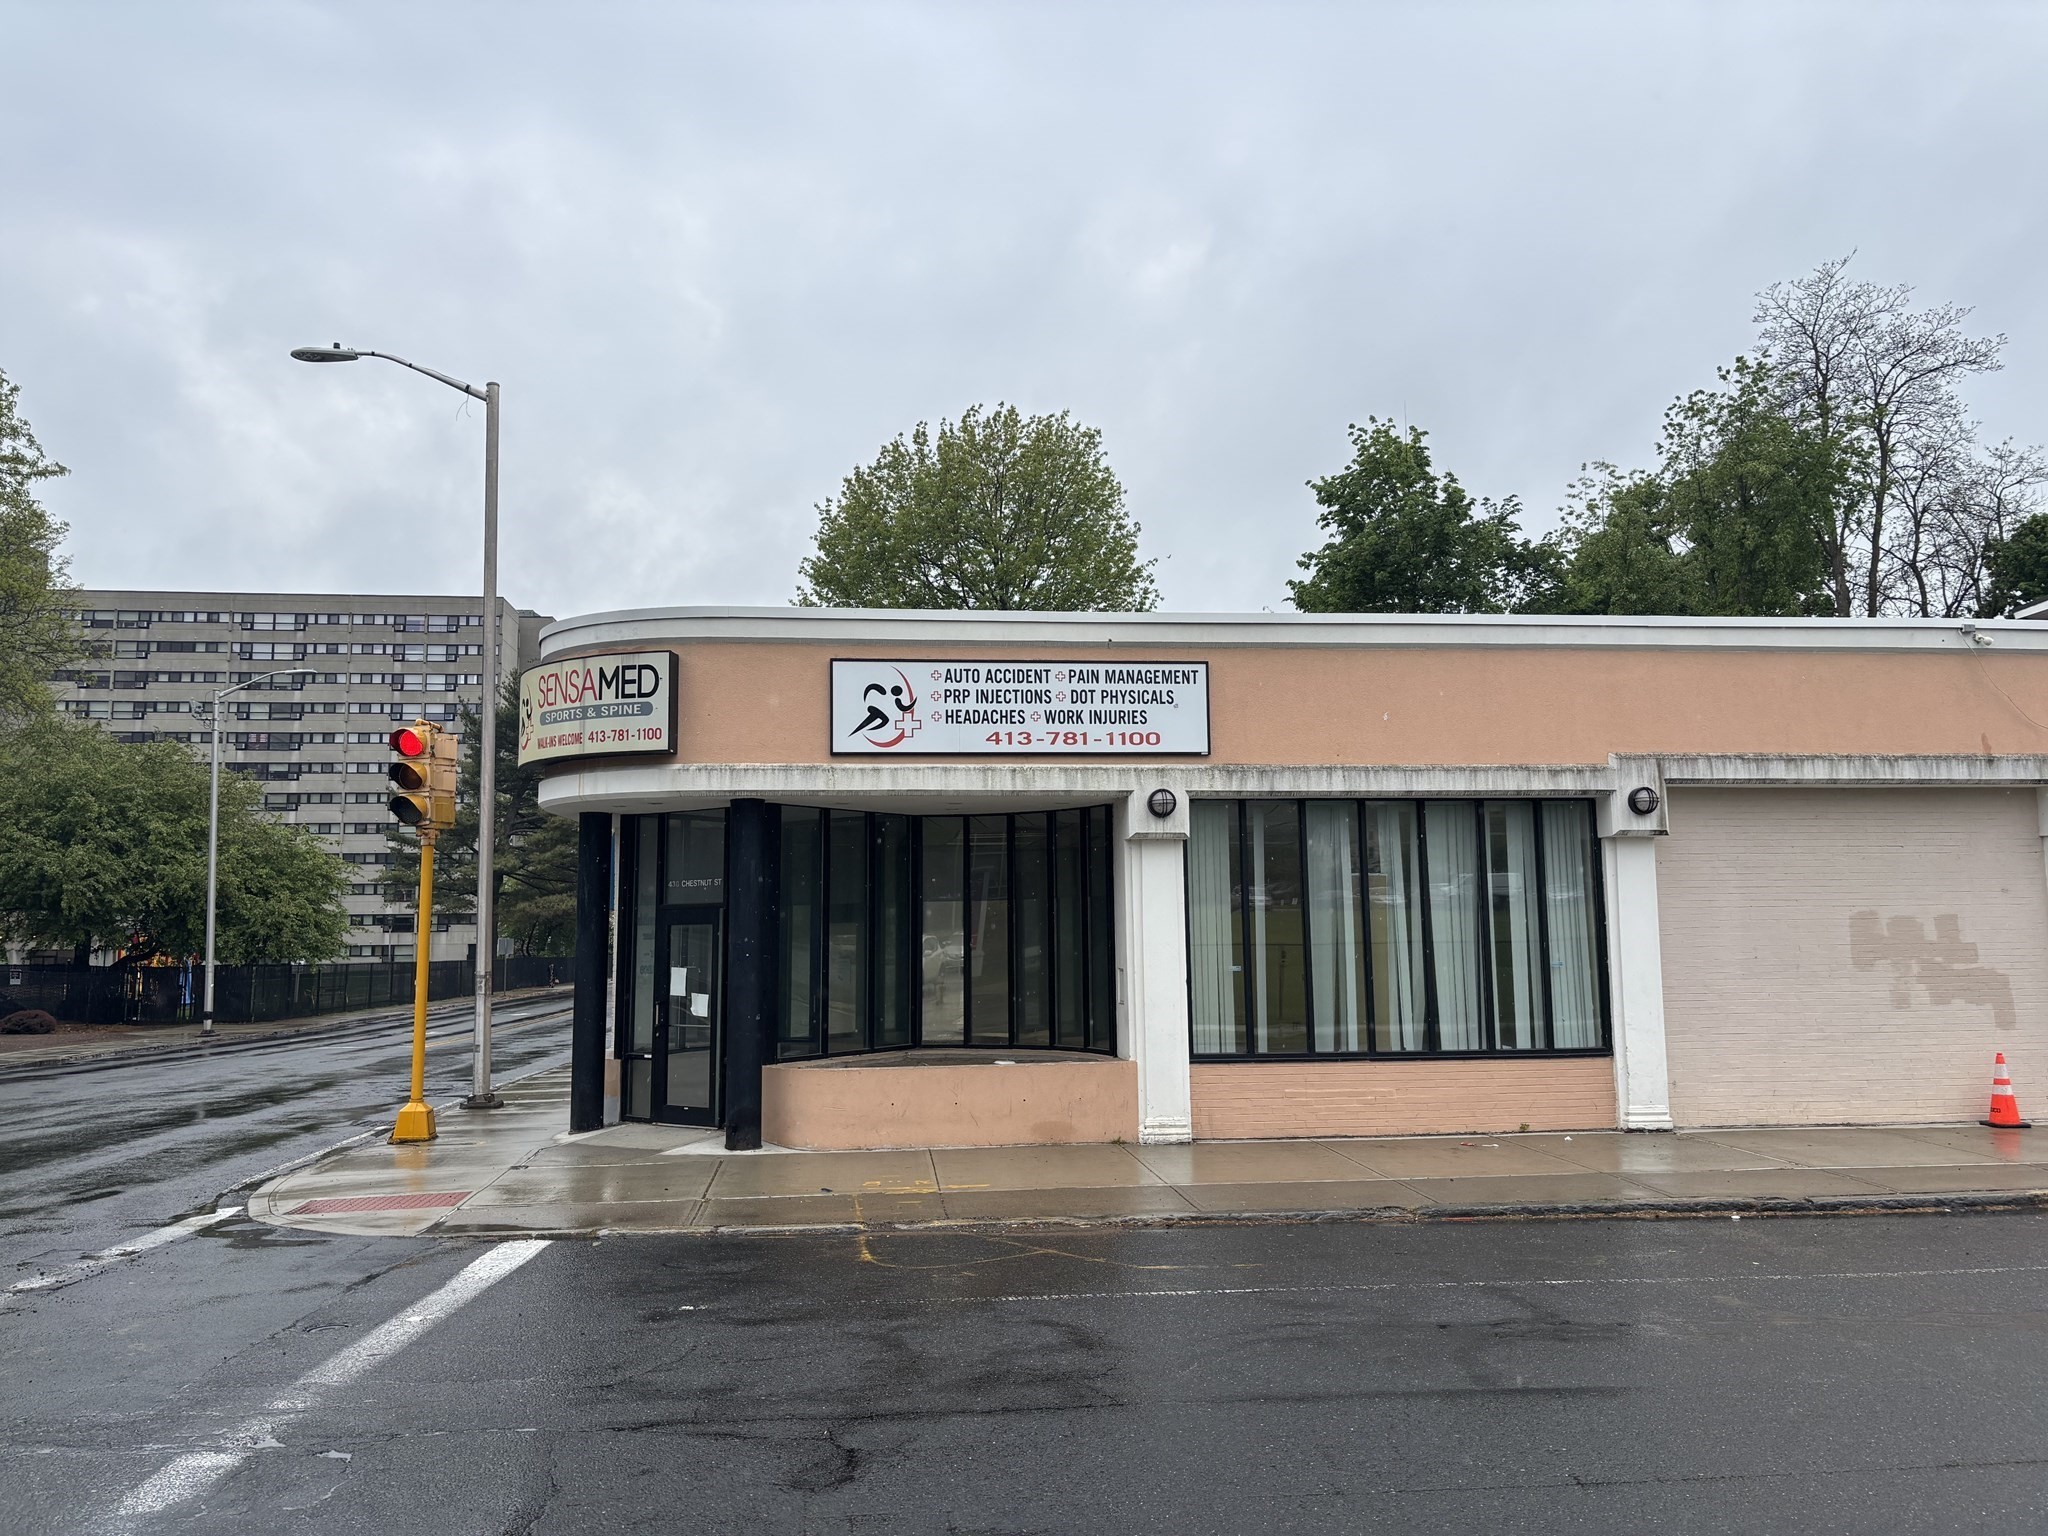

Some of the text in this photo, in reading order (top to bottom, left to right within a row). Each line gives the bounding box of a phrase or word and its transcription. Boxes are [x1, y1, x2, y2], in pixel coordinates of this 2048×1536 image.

[944, 668, 1199, 685] AUTO ACCIDENT PAIN MANAGEMENT
[538, 664, 660, 708] SENSAMED
[944, 689, 1174, 705] PRP INJECTIONS DOT PHYSICALS
[545, 704, 642, 723] SPORTS & SPINE
[945, 709, 1148, 725] HEADACHES WORK INJURIES
[537, 727, 662, 750] WALK-INS WELCOME 413-781-1100
[985, 731, 1161, 746] 413-781-1100
[681, 879, 712, 887] CHESTNUT
[714, 878, 722, 886] ST
